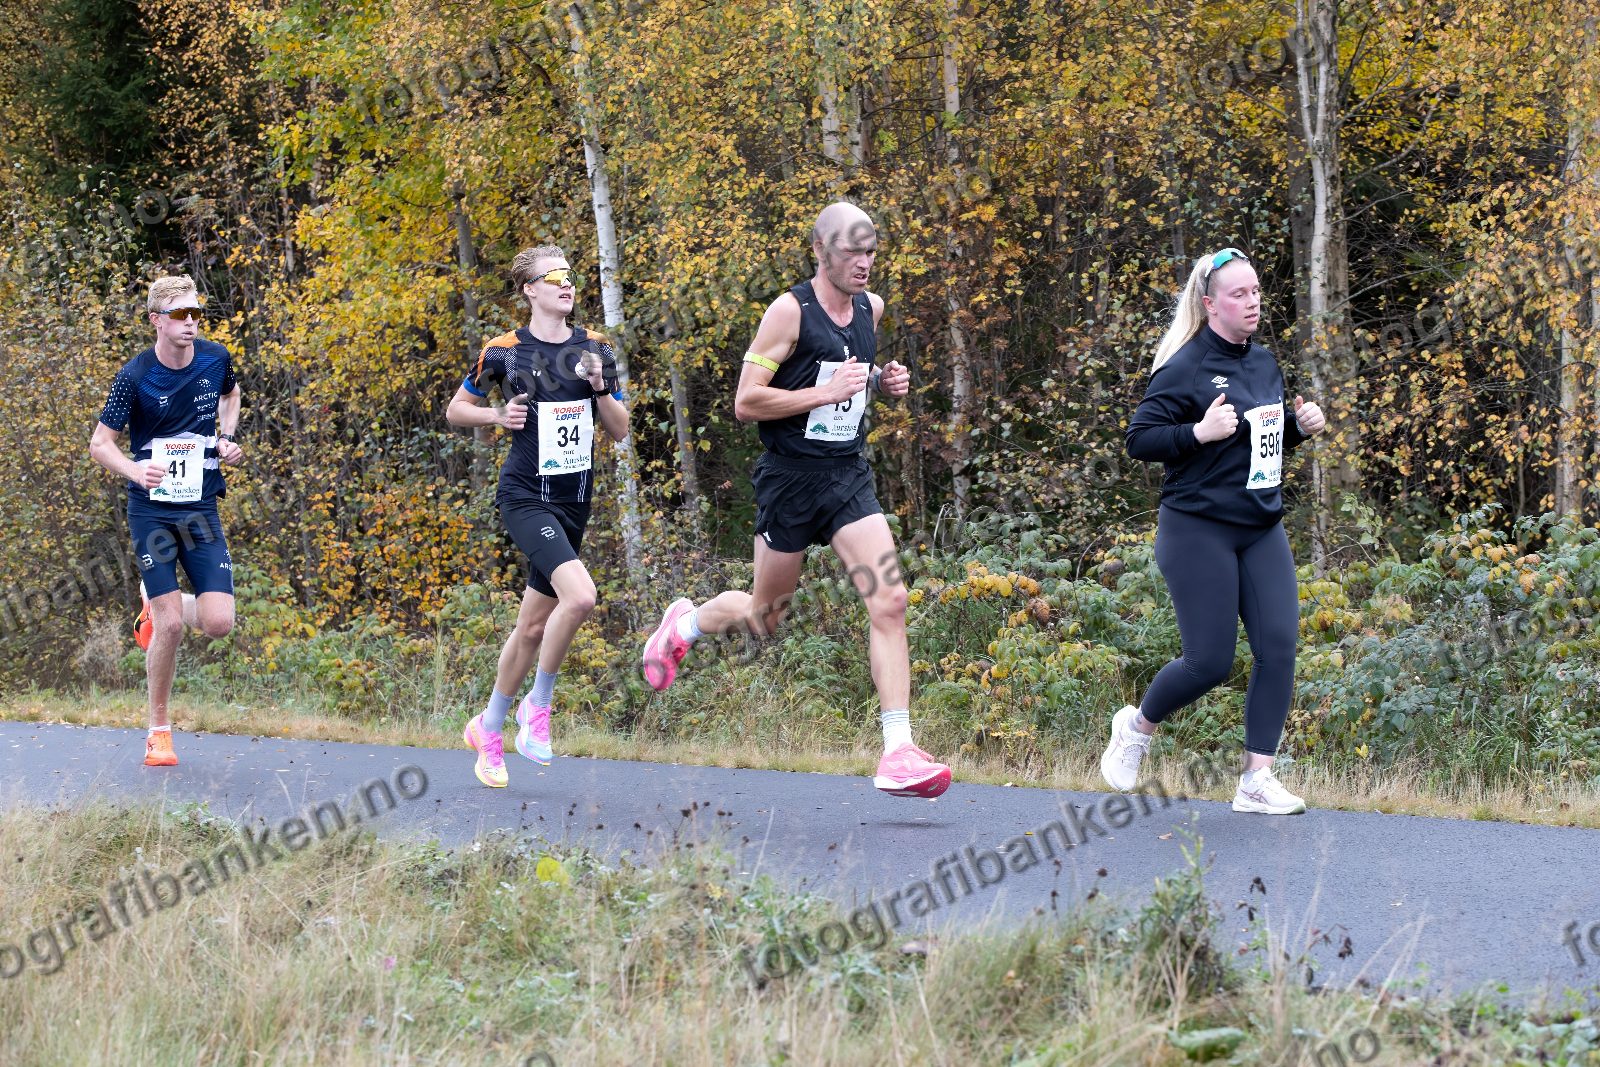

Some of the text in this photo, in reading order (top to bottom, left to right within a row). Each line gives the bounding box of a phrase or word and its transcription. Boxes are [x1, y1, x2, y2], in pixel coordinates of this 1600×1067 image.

[193, 391, 218, 403] ARCTIC
[553, 404, 585, 415] NORGES
[555, 412, 582, 421] LØPET
[557, 425, 581, 448] 34
[168, 459, 186, 479] 41
